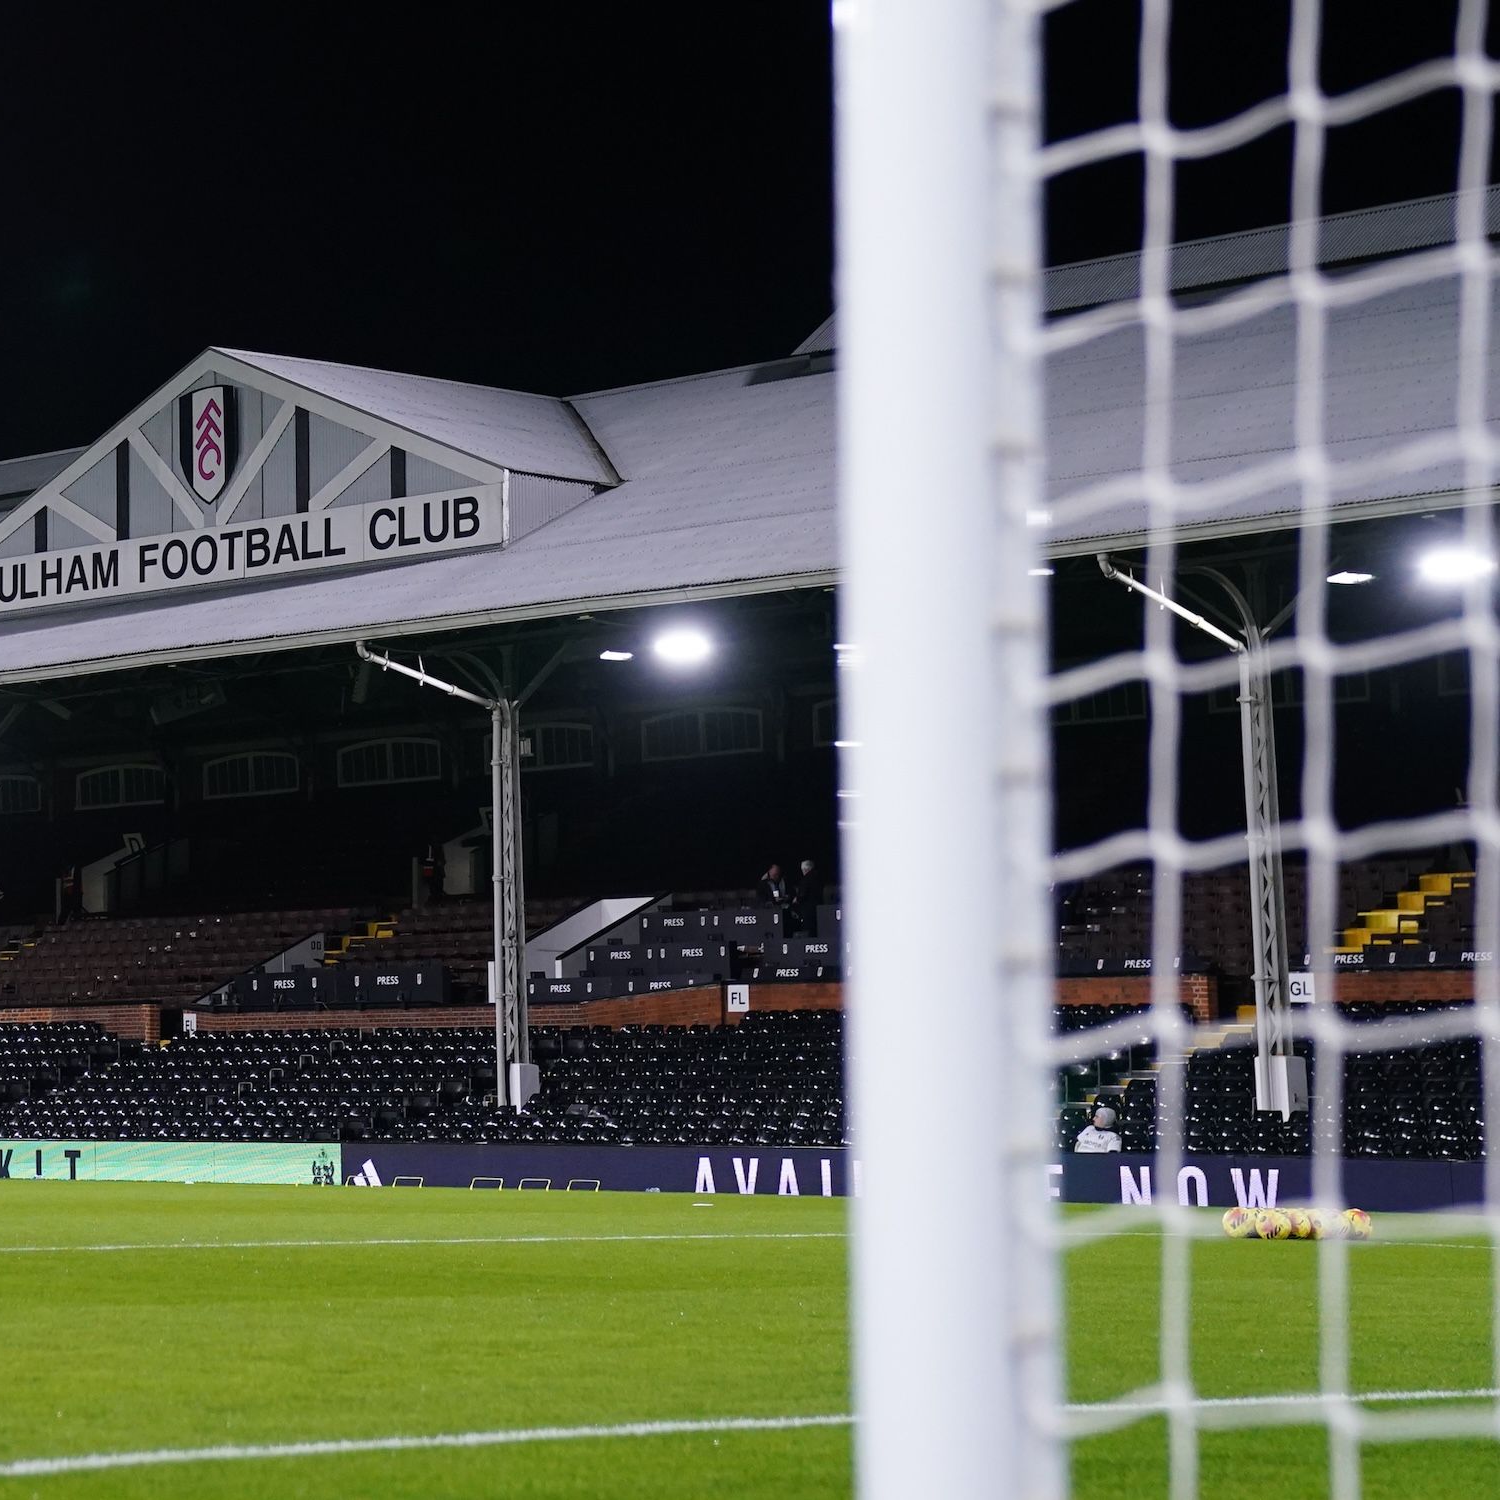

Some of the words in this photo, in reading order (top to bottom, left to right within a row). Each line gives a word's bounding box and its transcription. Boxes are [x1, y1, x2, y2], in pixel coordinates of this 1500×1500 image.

[196, 398, 222, 481] FFC
[139, 517, 346, 583] FOOTBALL
[369, 496, 480, 551] CLUB
[663, 917, 684, 927] PRESS
[735, 915, 757, 925] PRESS
[682, 948, 703, 957] PRESS
[805, 943, 828, 953] PRESS
[610, 950, 631, 960] PRESS
[1334, 954, 1364, 964] PRESS
[1461, 951, 1492, 962] PRESS
[1124, 959, 1151, 969] PRESS
[776, 968, 799, 977] PRESS
[274, 979, 295, 990] PRESS
[377, 976, 399, 986] PRESS
[650, 981, 672, 990] PRESS
[550, 984, 571, 993] PRESS
[1290, 981, 1312, 996] GL
[731, 992, 746, 1005] FL
[1119, 1165, 1280, 1209] NOW
